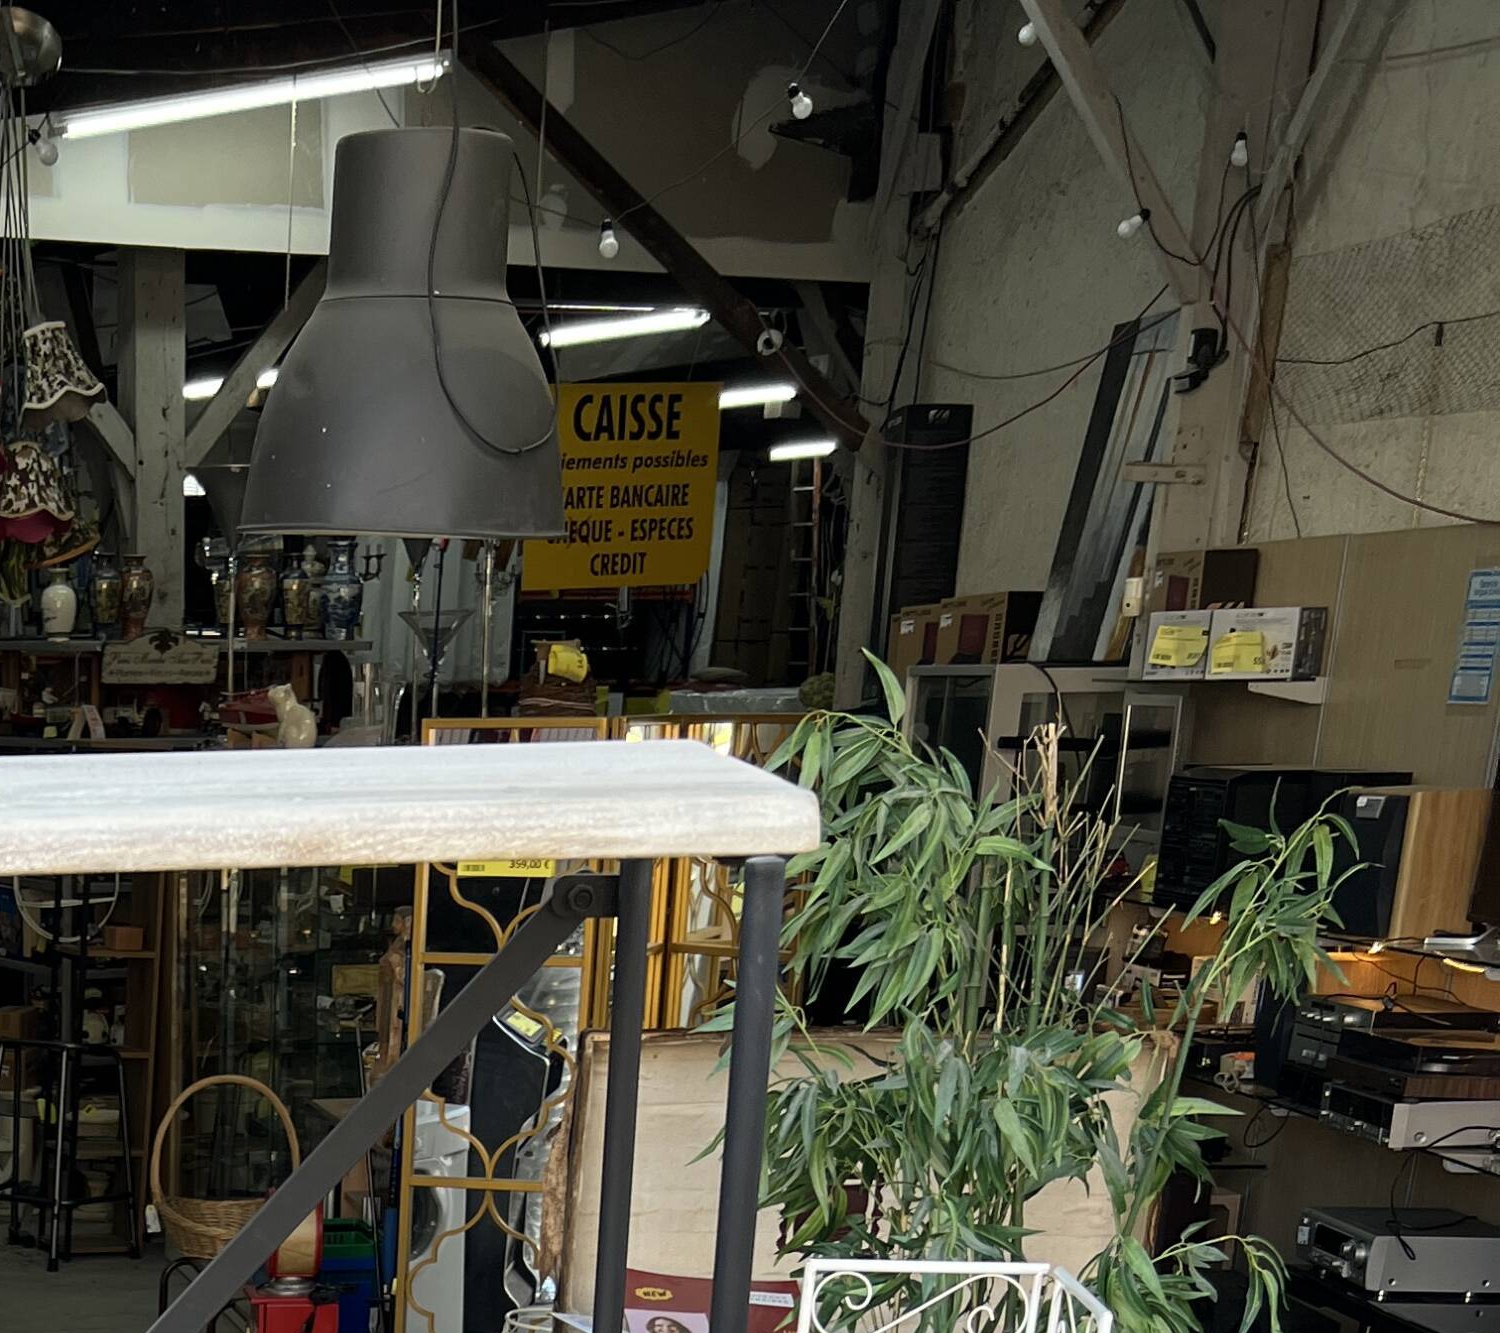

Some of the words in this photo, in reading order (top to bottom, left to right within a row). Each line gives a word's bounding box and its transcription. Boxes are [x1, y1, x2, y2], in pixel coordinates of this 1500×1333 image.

[573, 393, 684, 442] CAISSE
[561, 452, 628, 471] iements
[632, 450, 709, 473] possibles
[563, 486, 604, 510] ARTE
[610, 484, 690, 508] BANCAIRE
[630, 517, 694, 542] ESPECES
[590, 552, 647, 576] CREDIT
[509, 859, 542, 870] 359,00
